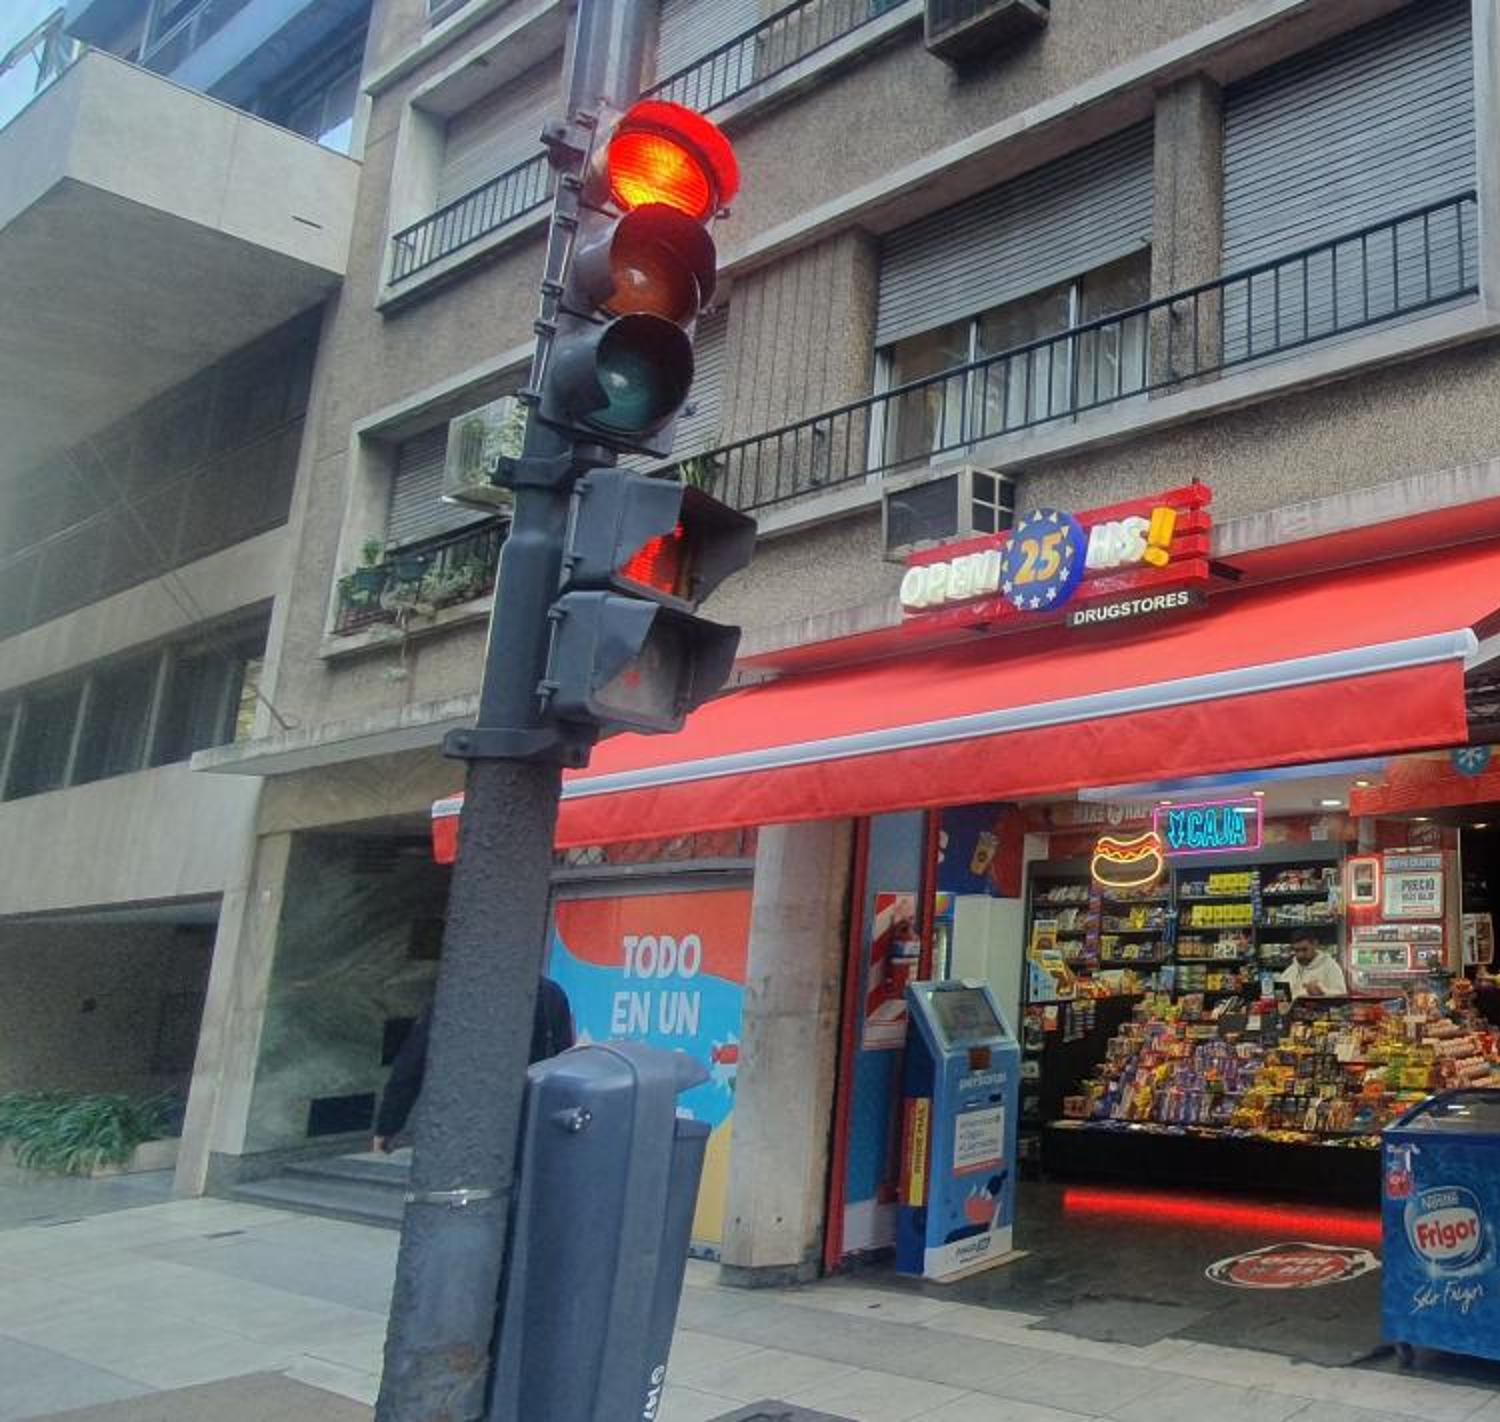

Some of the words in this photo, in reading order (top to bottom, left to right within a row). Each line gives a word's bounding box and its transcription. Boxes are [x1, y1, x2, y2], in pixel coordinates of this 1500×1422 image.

[900, 549, 1001, 608] OPEN
[1014, 530, 1063, 584] 25
[1073, 591, 1189, 625] DRUGSTORES
[1187, 808, 1246, 847] CAJA
[622, 934, 701, 979] TODO
[611, 991, 650, 1036] EN
[659, 991, 699, 1035] UN
[1416, 1216, 1477, 1249] Frigor
